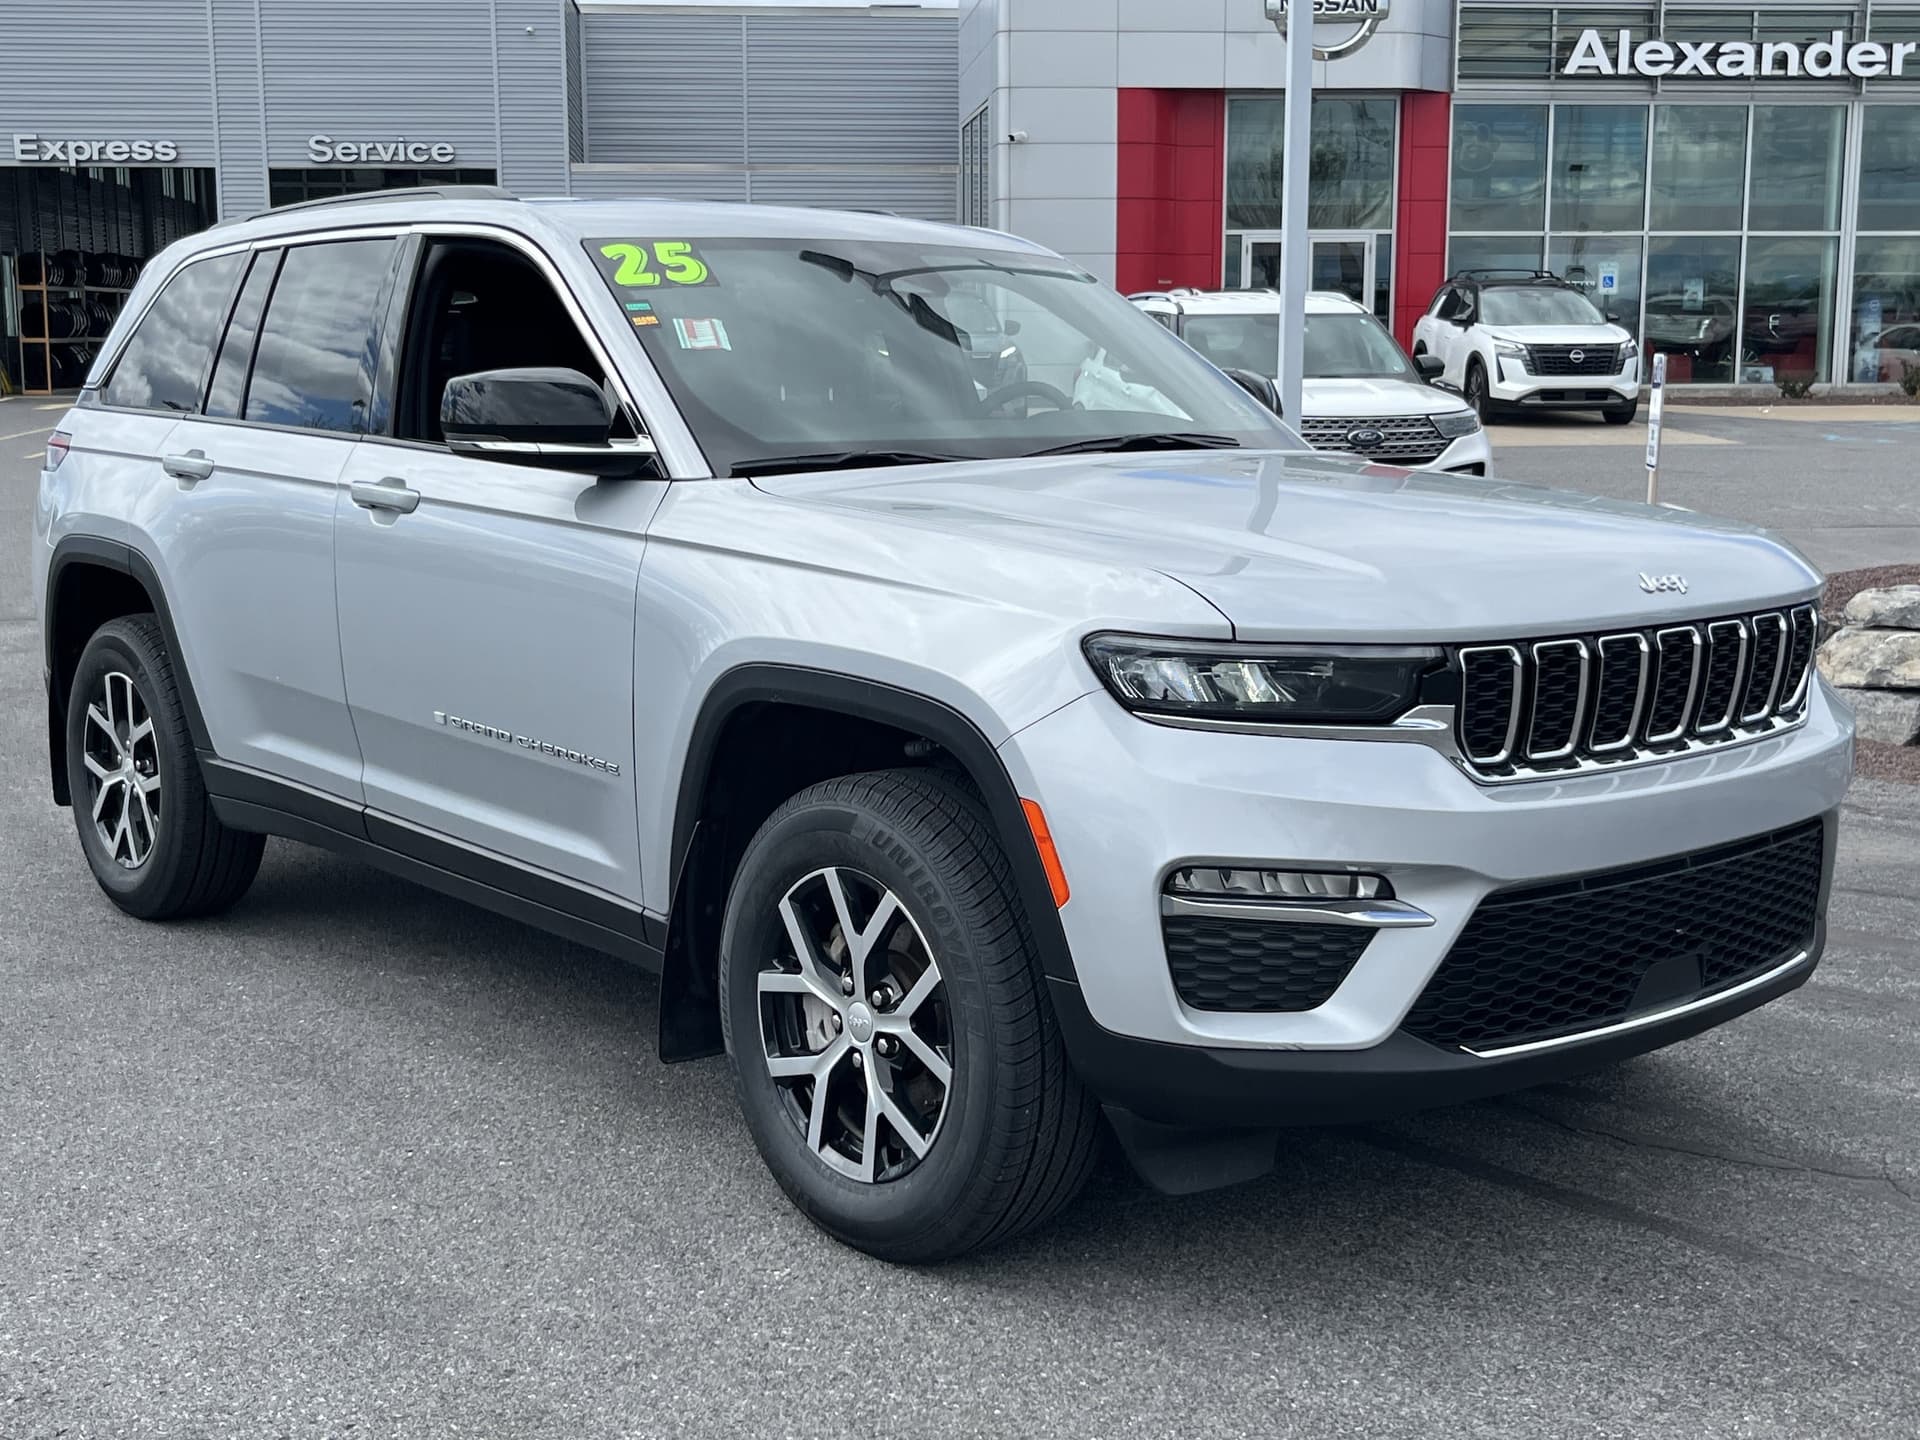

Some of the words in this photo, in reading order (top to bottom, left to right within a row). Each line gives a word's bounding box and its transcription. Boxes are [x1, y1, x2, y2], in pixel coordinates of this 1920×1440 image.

[1563, 29, 1917, 77] Alexander
[13, 133, 178, 167] Express
[308, 134, 455, 163] Service
[600, 241, 708, 287] 25
[1638, 571, 1688, 595] Jeep
[450, 715, 513, 743] GRAND
[516, 735, 621, 777] CHEROKEE
